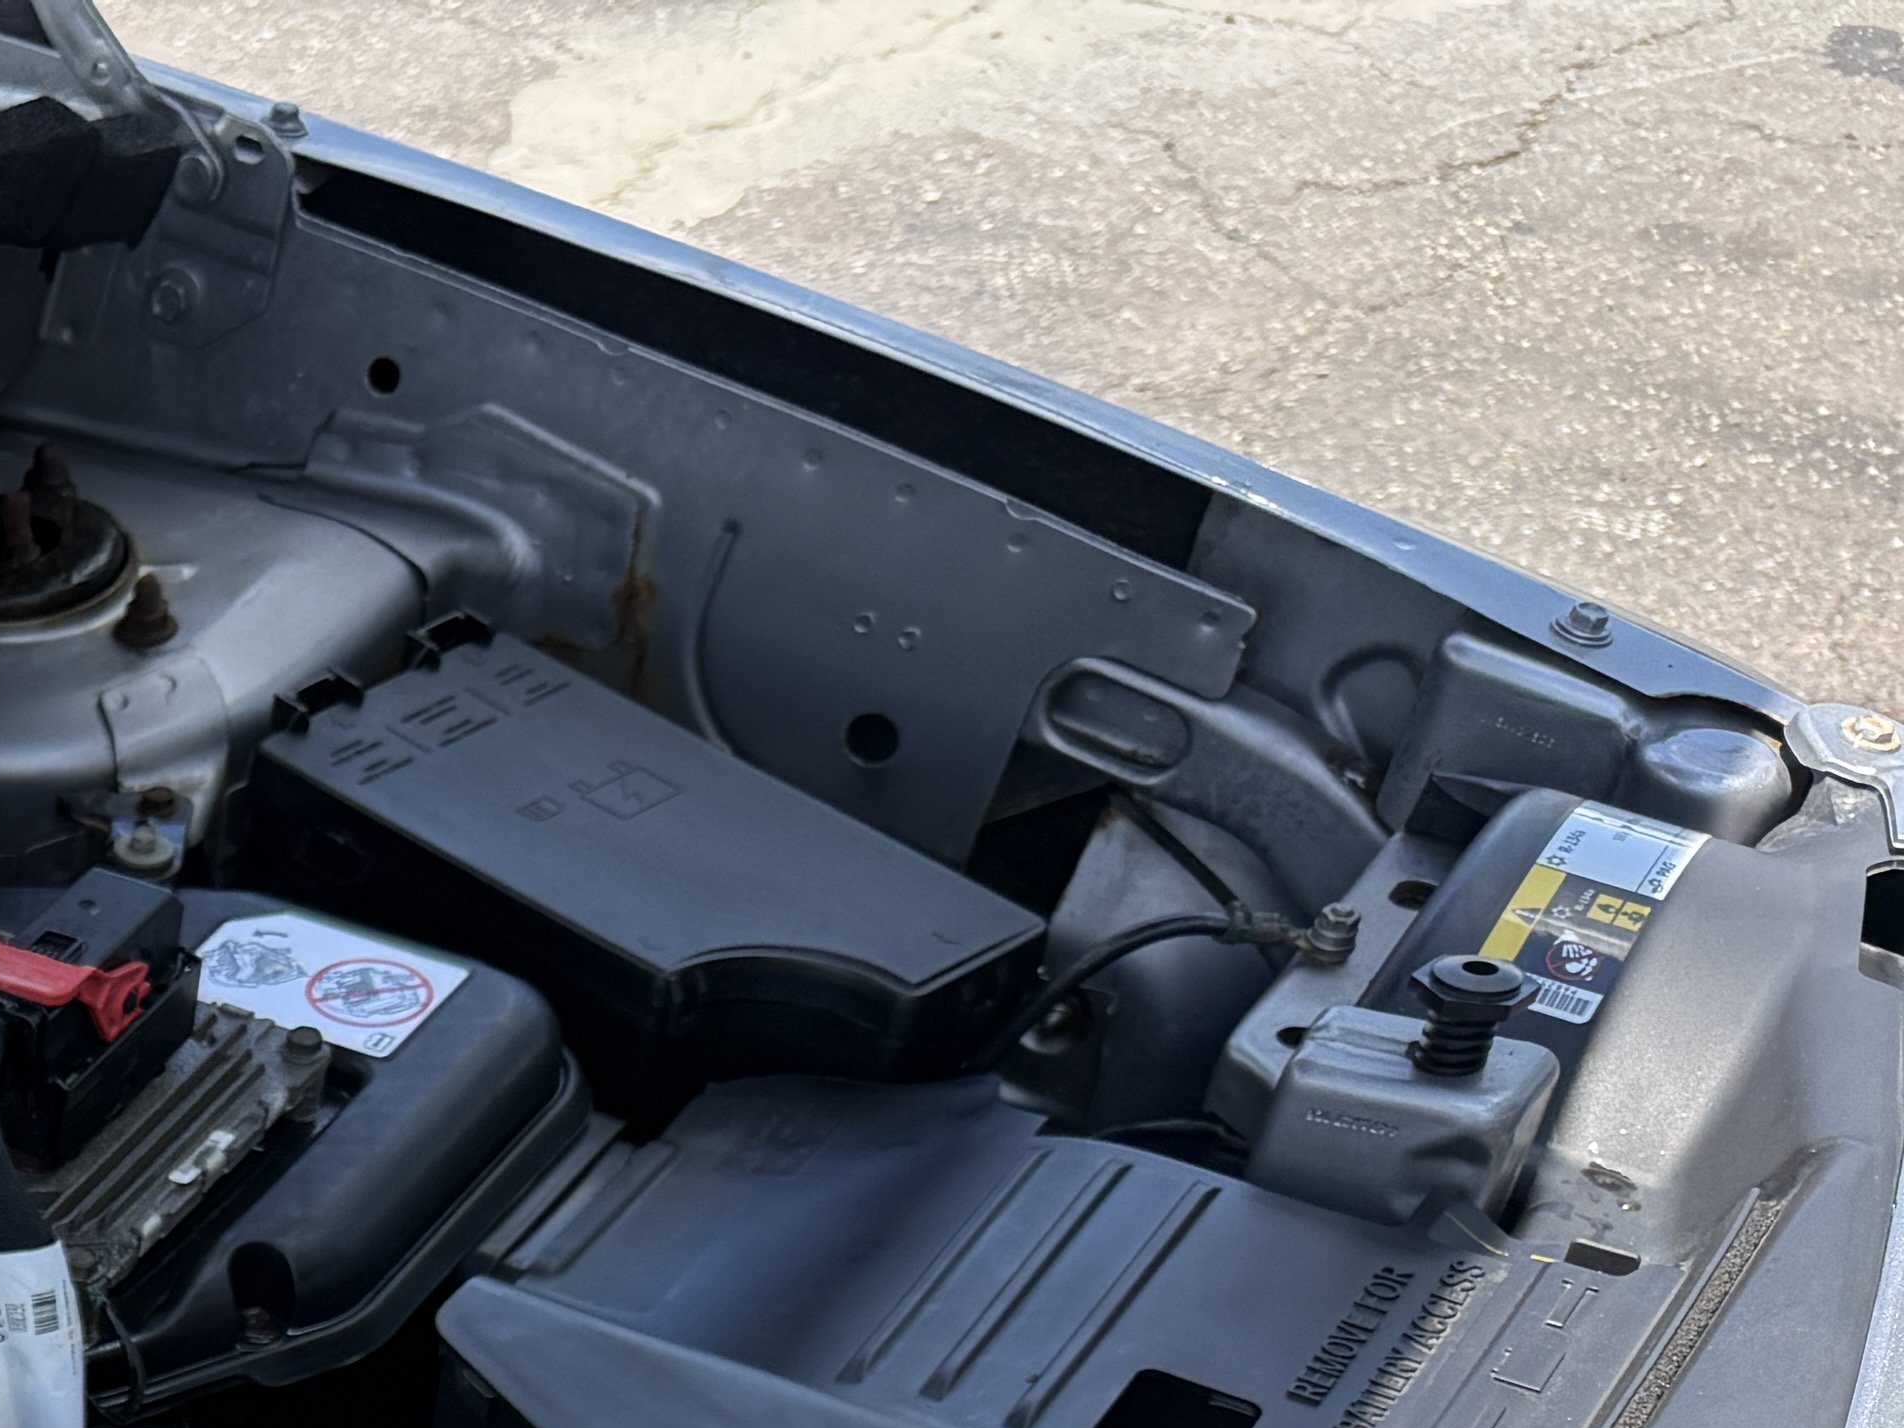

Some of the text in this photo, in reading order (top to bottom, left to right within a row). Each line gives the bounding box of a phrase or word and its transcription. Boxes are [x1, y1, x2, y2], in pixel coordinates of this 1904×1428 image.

[1285, 1266, 1415, 1409] REMOVE FOR
[1401, 1259, 1486, 1353] ACCESS
